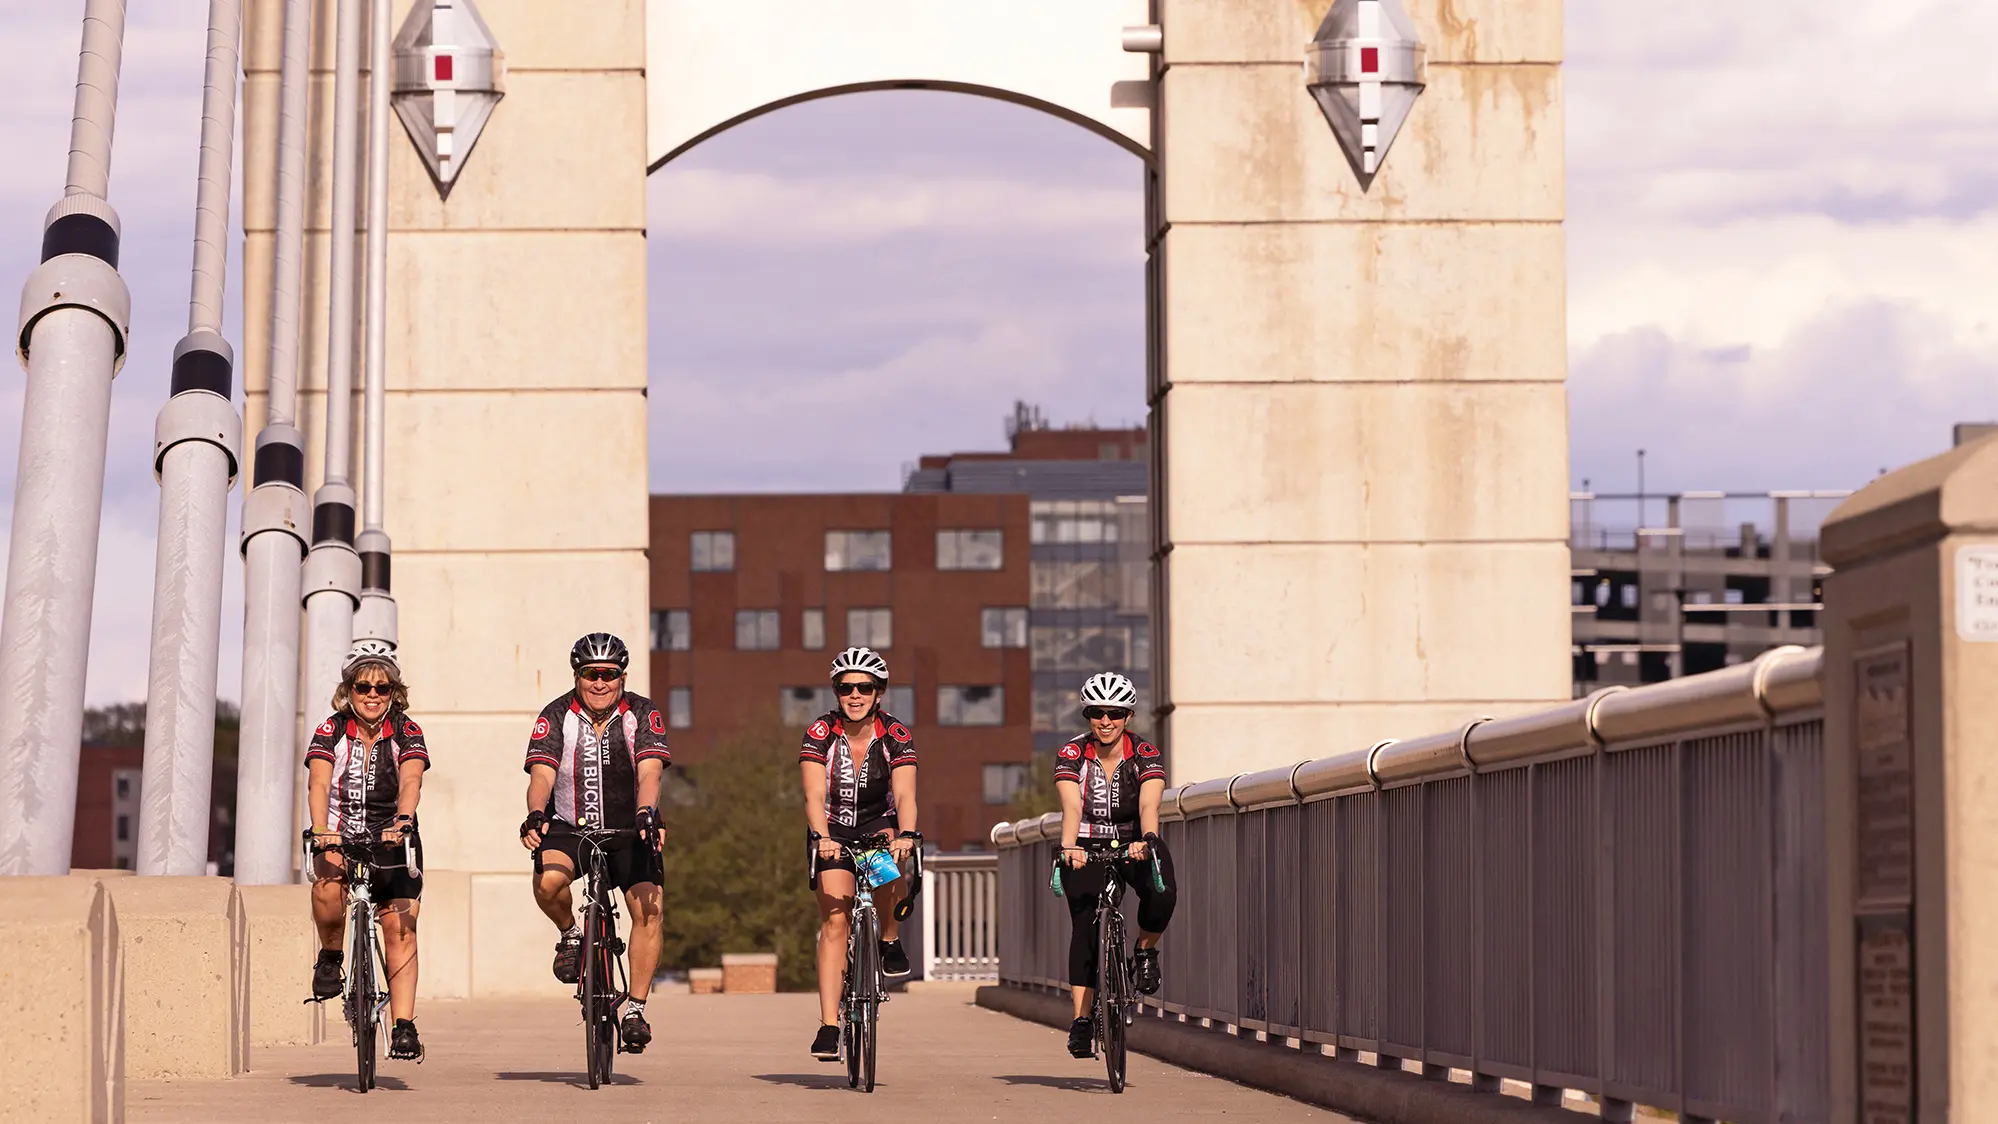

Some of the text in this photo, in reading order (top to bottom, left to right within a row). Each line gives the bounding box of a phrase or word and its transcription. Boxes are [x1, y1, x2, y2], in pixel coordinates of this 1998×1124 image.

[583, 724, 597, 761] EAM
[602, 739, 610, 765] STATE
[348, 745, 363, 784] EAM
[367, 764, 376, 791] STATE
[840, 745, 854, 783] EAM
[859, 761, 869, 788] STATE
[1093, 766, 1107, 803] EAM
[1111, 781, 1120, 808] STATE
